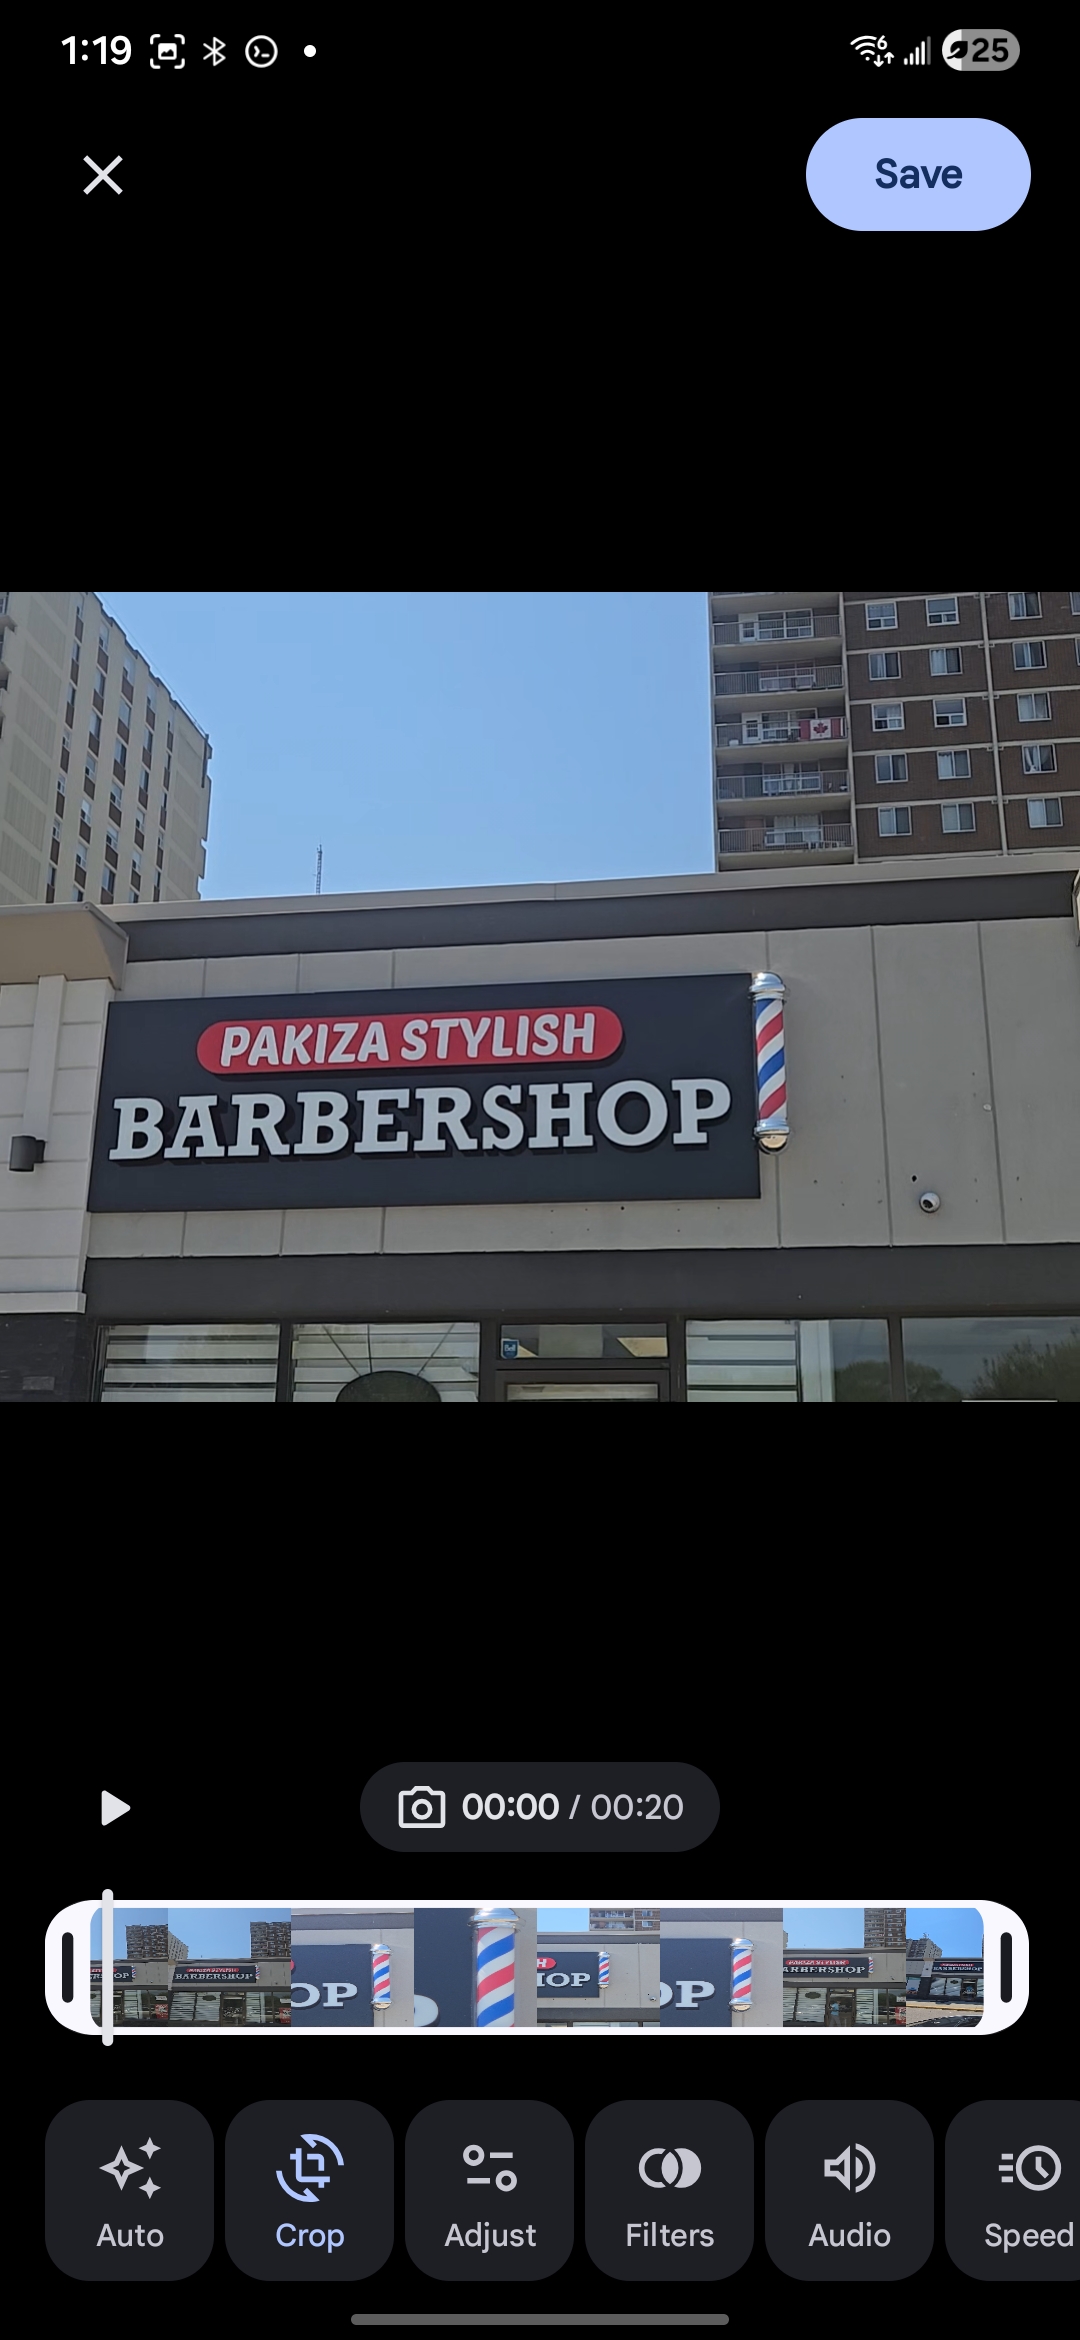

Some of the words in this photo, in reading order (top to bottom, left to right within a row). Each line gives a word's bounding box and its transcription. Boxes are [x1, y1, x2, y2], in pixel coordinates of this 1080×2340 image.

[61, 35, 131, 65] 1:19
[971, 37, 1009, 63] 25
[875, 158, 962, 189] Save
[220, 1022, 389, 1067] PAKIZA
[401, 1013, 595, 1061] STYLISH
[109, 1078, 731, 1160] BARBERSHOP
[462, 1793, 559, 1820] 00:00
[568, 1794, 581, 1820] /
[591, 1793, 683, 1820] 00:20
[96, 2223, 164, 2247] Auto
[276, 2223, 344, 2253] Crop
[444, 2222, 536, 2253] Adjust
[627, 2222, 714, 2247] Filters
[808, 2222, 891, 2247] Audio
[985, 2222, 1073, 2253] Speed
